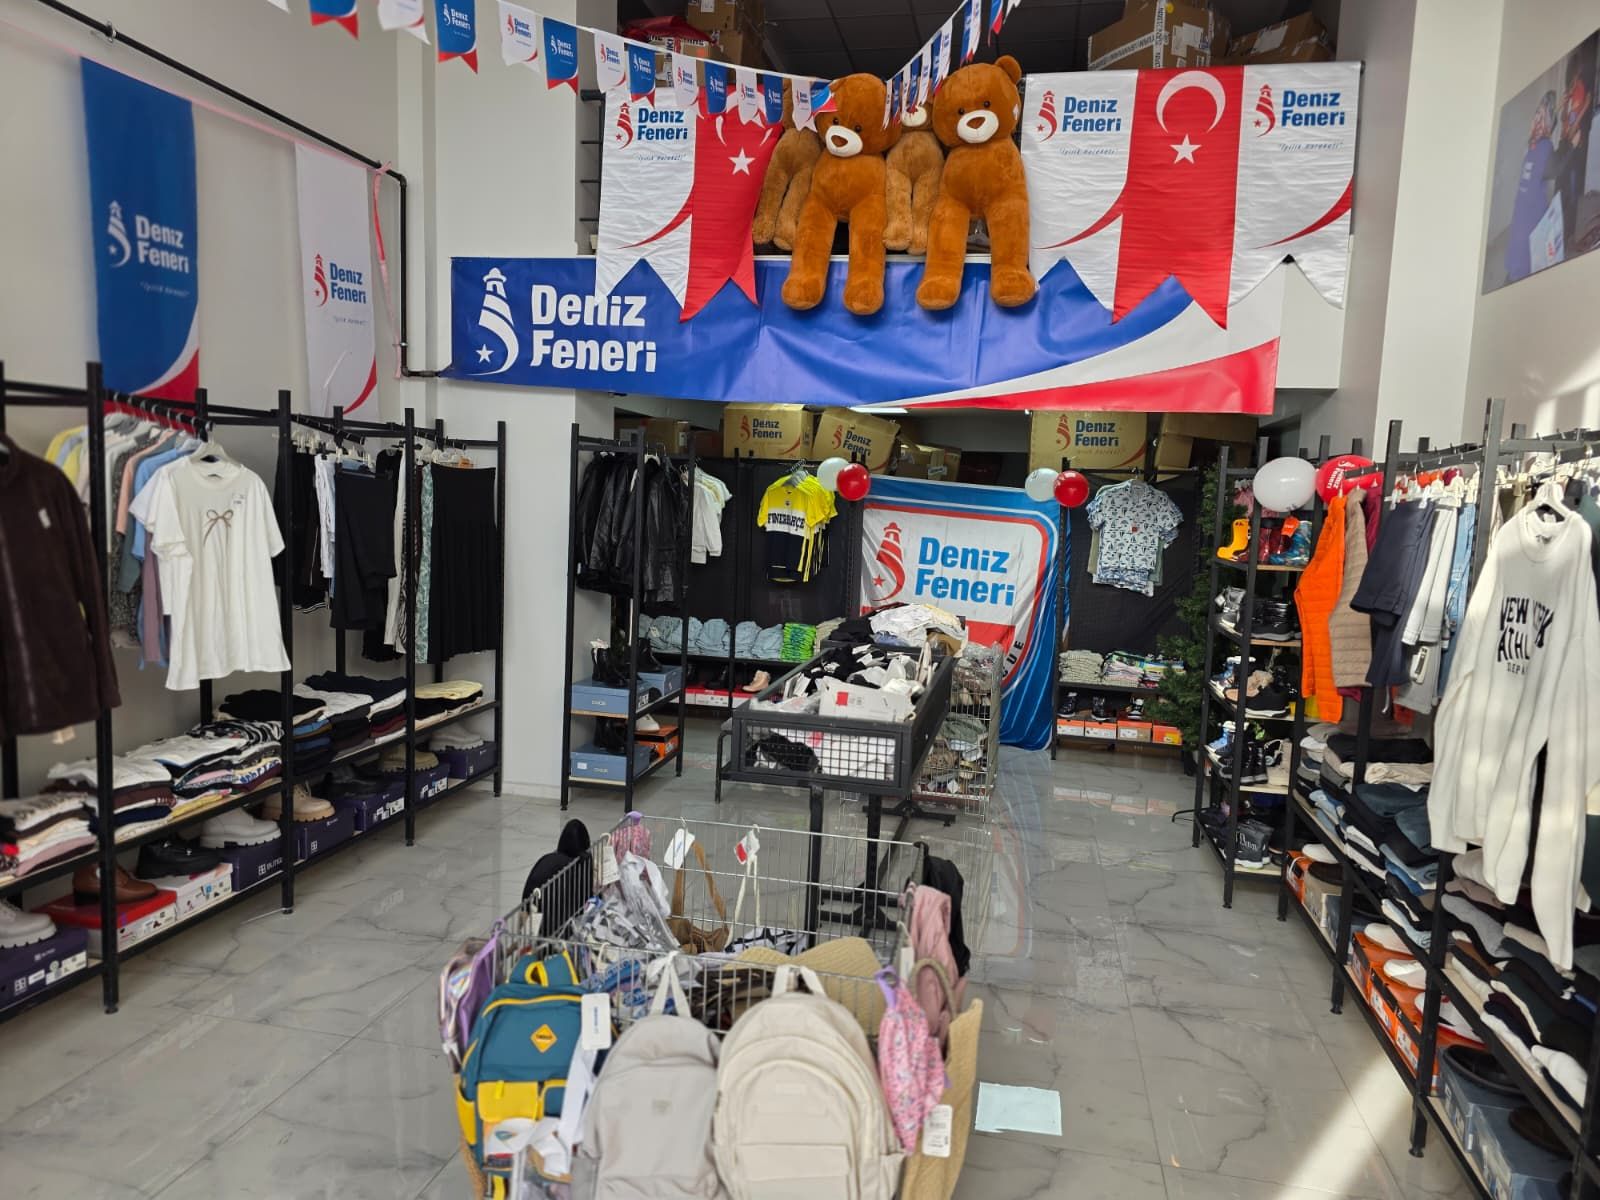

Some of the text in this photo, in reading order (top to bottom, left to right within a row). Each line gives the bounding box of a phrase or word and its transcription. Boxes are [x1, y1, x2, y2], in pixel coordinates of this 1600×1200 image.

[1064, 97, 1118, 113] Deniz
[1282, 90, 1341, 107] Deniz
[638, 107, 684, 124] Deniz
[1062, 115, 1122, 132] Feneri
[1281, 109, 1345, 127] Feneri
[638, 125, 688, 140] Feneri
[136, 214, 184, 249] Deniz
[137, 241, 189, 274] Feneri
[329, 262, 363, 285] Deniz
[330, 281, 367, 304] Feneri
[531, 284, 647, 327] Deniz
[530, 329, 657, 373] Feneri
[752, 418, 780, 429] Deniz
[1075, 419, 1116, 433] Deniz
[752, 428, 783, 439] Feneri
[845, 430, 872, 446] Deniz
[1074, 433, 1119, 447] Feneri
[842, 439, 871, 456] Feneri
[918, 536, 1010, 573] Deniz
[915, 568, 1015, 606] Feneri
